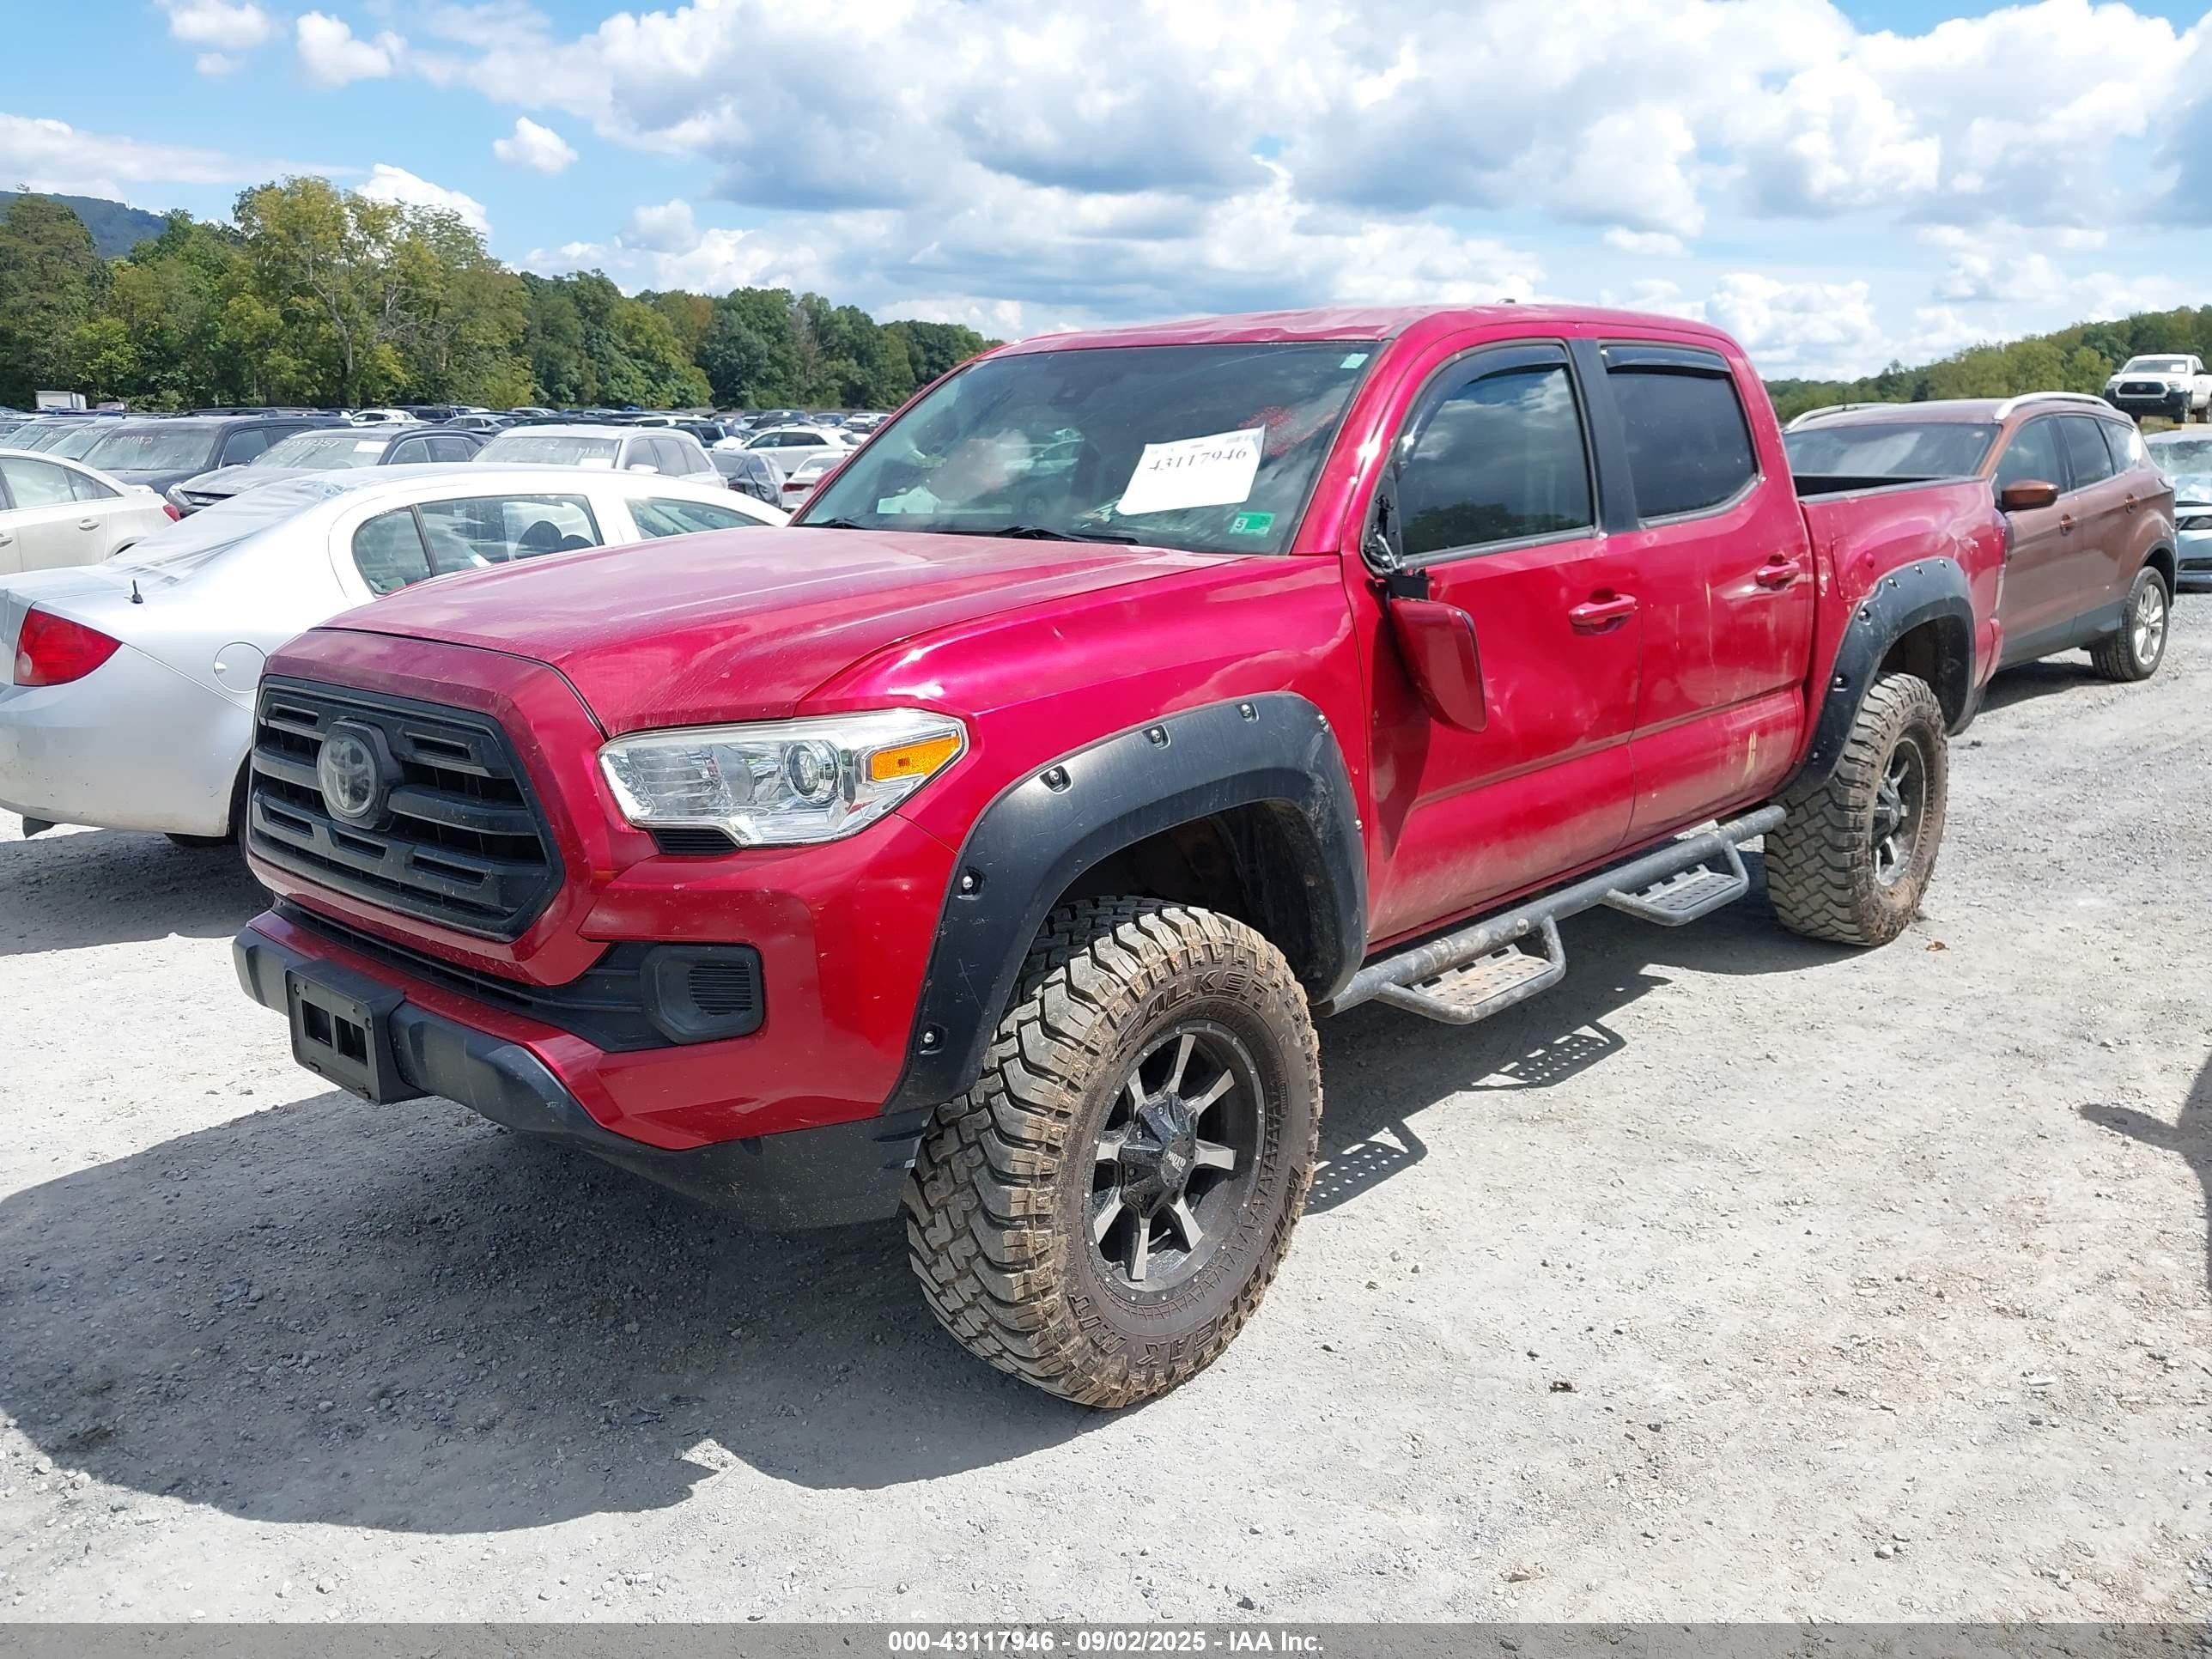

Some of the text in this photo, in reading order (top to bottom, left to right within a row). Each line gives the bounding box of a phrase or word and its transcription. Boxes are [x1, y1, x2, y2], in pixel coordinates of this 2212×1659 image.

[1149, 447, 1248, 471] 43117946
[1236, 520, 1244, 529] 5
[1110, 969, 1271, 1063] FALKEN
[1166, 1151, 1187, 1168] MOTO
